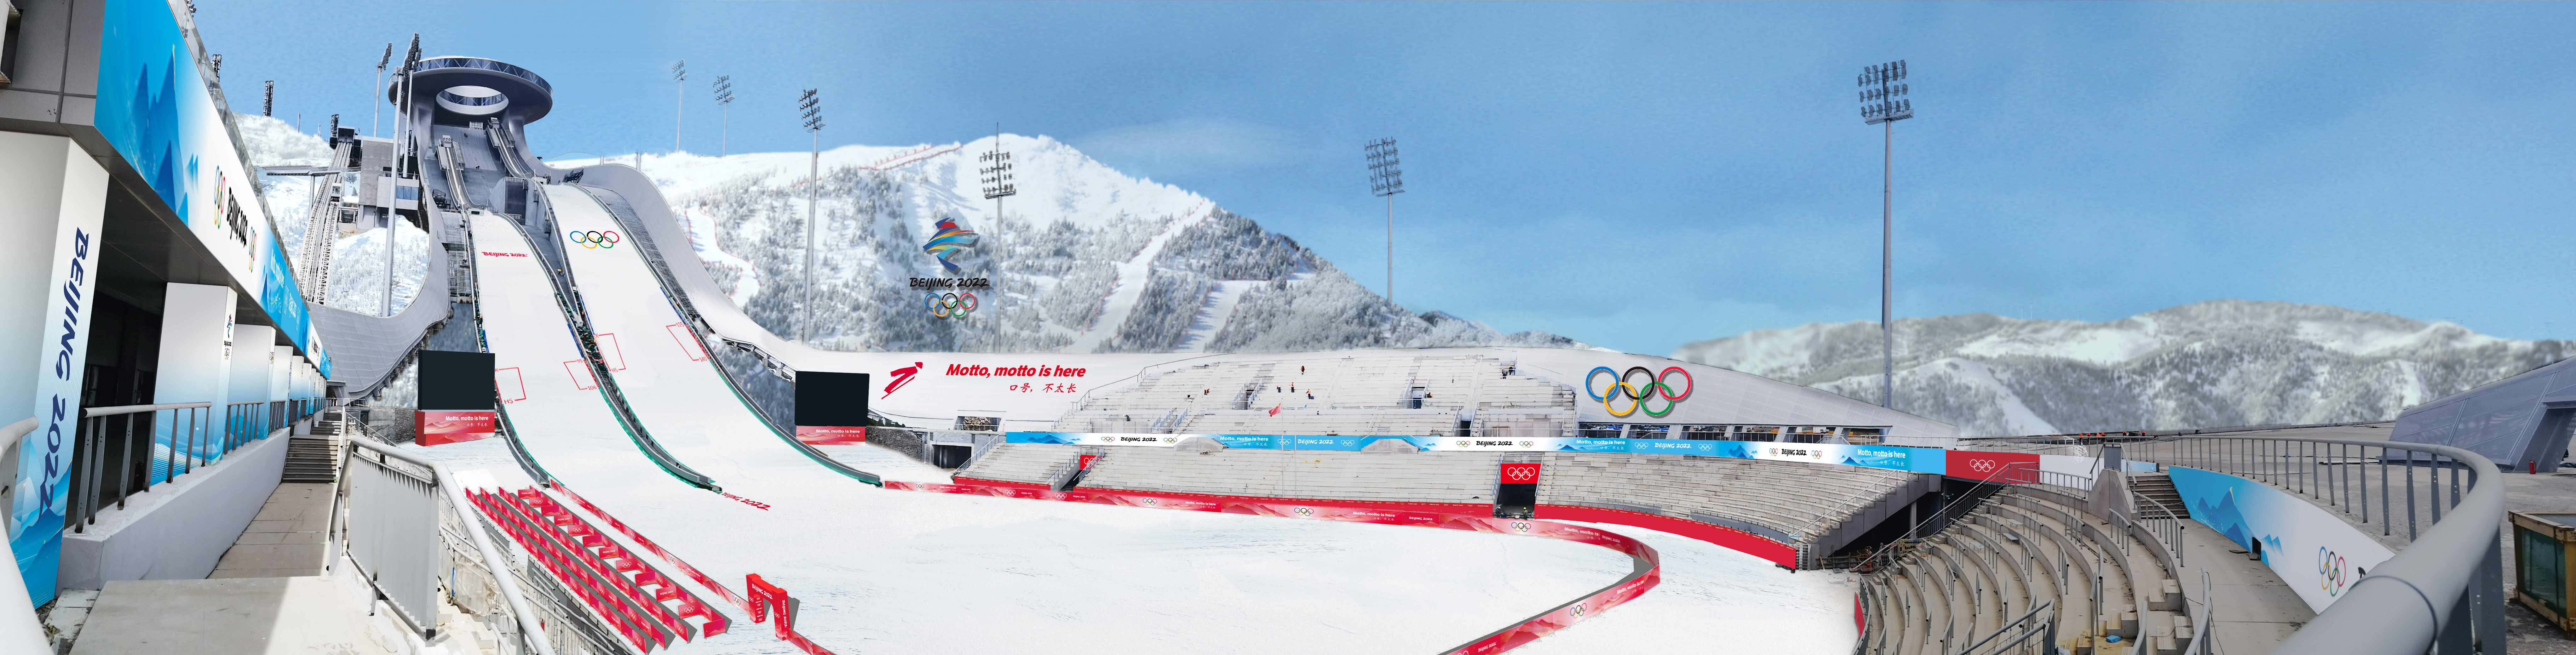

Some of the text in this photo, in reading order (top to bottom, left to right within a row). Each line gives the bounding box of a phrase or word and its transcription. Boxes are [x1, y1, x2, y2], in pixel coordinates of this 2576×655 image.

[909, 278, 990, 290] BEIJING 2022
[38, 227, 89, 525] BEIJING 2022
[946, 364, 1086, 378] Motto, motto is here
[1010, 383, 1076, 393] 口号，不太长
[740, 499, 771, 511] 2022
[752, 584, 773, 600] BEIJING 2022
